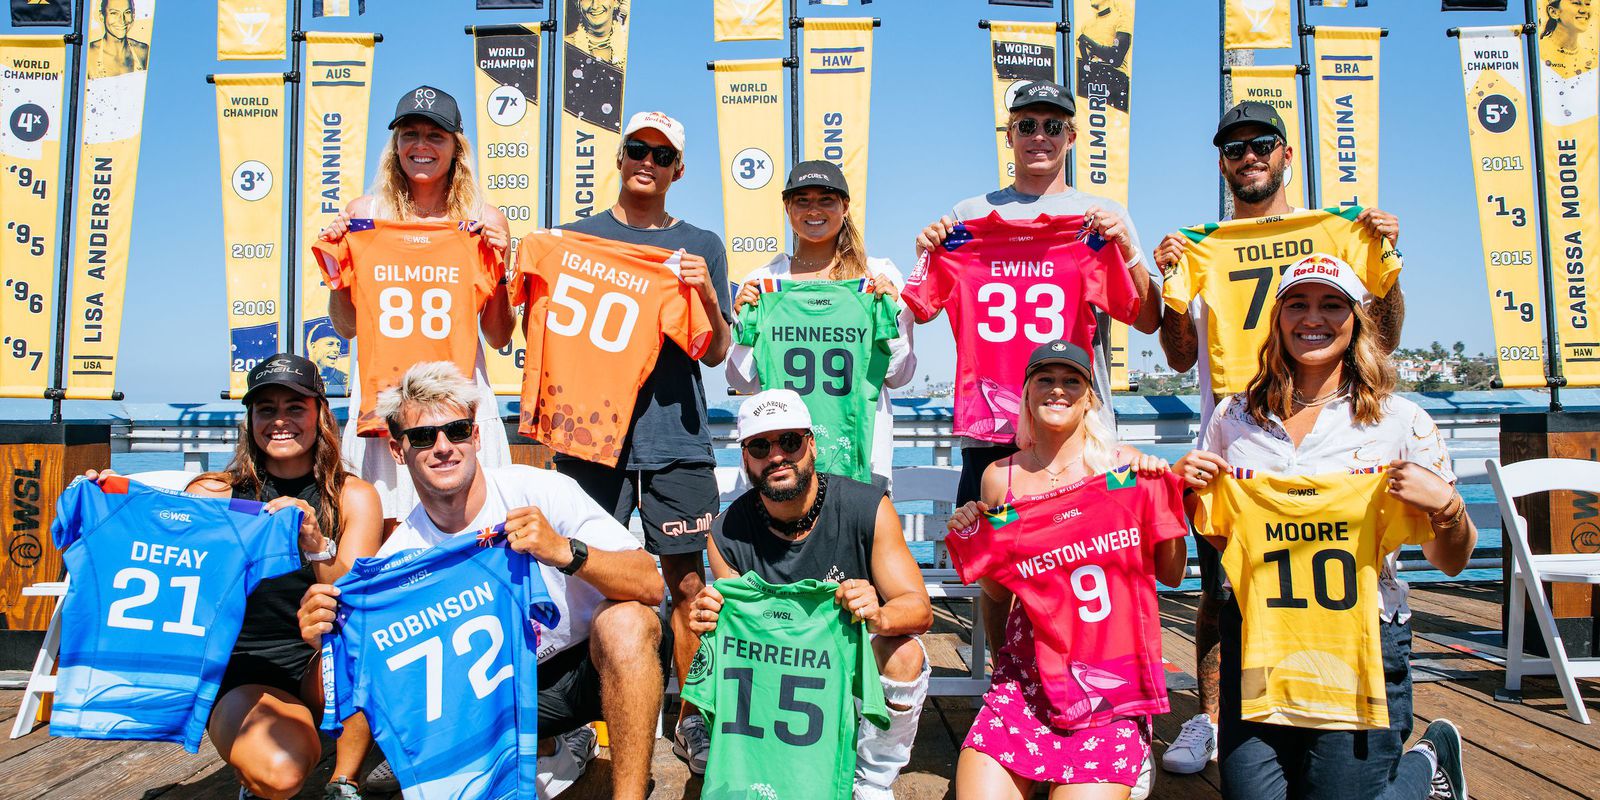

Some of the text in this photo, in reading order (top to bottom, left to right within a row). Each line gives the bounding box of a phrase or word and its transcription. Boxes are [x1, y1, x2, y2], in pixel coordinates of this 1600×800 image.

[488, 48, 525, 57] WORLD
[1005, 44, 1041, 54] WORLD
[1474, 51, 1509, 59] WORLD
[13, 59, 50, 69] WORLD
[480, 59, 534, 69] CHAMPION
[822, 56, 852, 67] HAW
[997, 55, 1051, 67] CHAMPION
[1335, 63, 1360, 74] BRA
[1467, 62, 1519, 71] CHAMPION
[4, 70, 59, 81] CHAMPION
[326, 68, 351, 79] AUS
[730, 83, 768, 93] WORLD
[1247, 88, 1283, 97] WORLD
[230, 97, 269, 107] WORLD
[722, 95, 777, 104] CHAMPION
[1240, 100, 1292, 108] PION
[223, 108, 278, 118] CHAMPION
[824, 112, 843, 168] ONS
[1088, 83, 1108, 185] GILMORE
[1335, 94, 1357, 182] MEDINA
[487, 143, 528, 158] 1998
[322, 113, 342, 214] FANNING
[1482, 156, 1524, 171] 2011
[487, 174, 529, 189] 1999
[575, 130, 594, 218] ACHLEY
[413, 236, 431, 244] WSL
[1558, 139, 1588, 328] CARISSA MOORE
[84, 157, 112, 342] LISA ANDERSEN
[232, 243, 275, 258] 2007
[732, 237, 778, 252] 2002
[1233, 239, 1314, 262] TOLEDO
[1490, 251, 1532, 265] 2015
[374, 265, 460, 283] GILMORE
[561, 251, 650, 295] IGARASHI
[991, 261, 1054, 277] EWING
[1293, 265, 1340, 277] Red Bull
[232, 300, 275, 315] 2009
[379, 287, 452, 340] 88
[546, 272, 640, 353] 50
[977, 282, 1065, 343] 33
[771, 326, 868, 343] HENNESSY
[1500, 346, 1540, 360] 2021
[1573, 348, 1593, 356] HAW
[83, 361, 102, 370] USA
[232, 357, 265, 372] 20
[783, 347, 854, 397] 99
[13, 460, 41, 531] WSL
[1297, 488, 1319, 496] WSL
[170, 511, 192, 523] WSL
[1062, 508, 1082, 520] WSL
[1265, 522, 1349, 541] MOORE
[131, 541, 208, 569] DEFAY
[1016, 527, 1141, 579] WESTON-WEBB
[408, 569, 433, 585] WSL
[1263, 548, 1358, 611] 10
[1070, 564, 1112, 623] 9
[107, 567, 206, 637] 21
[371, 581, 495, 652] ROBINSON
[773, 611, 793, 621] WSL
[722, 635, 832, 669] FERREIRA
[385, 614, 515, 723] 72
[721, 667, 826, 746] 15
